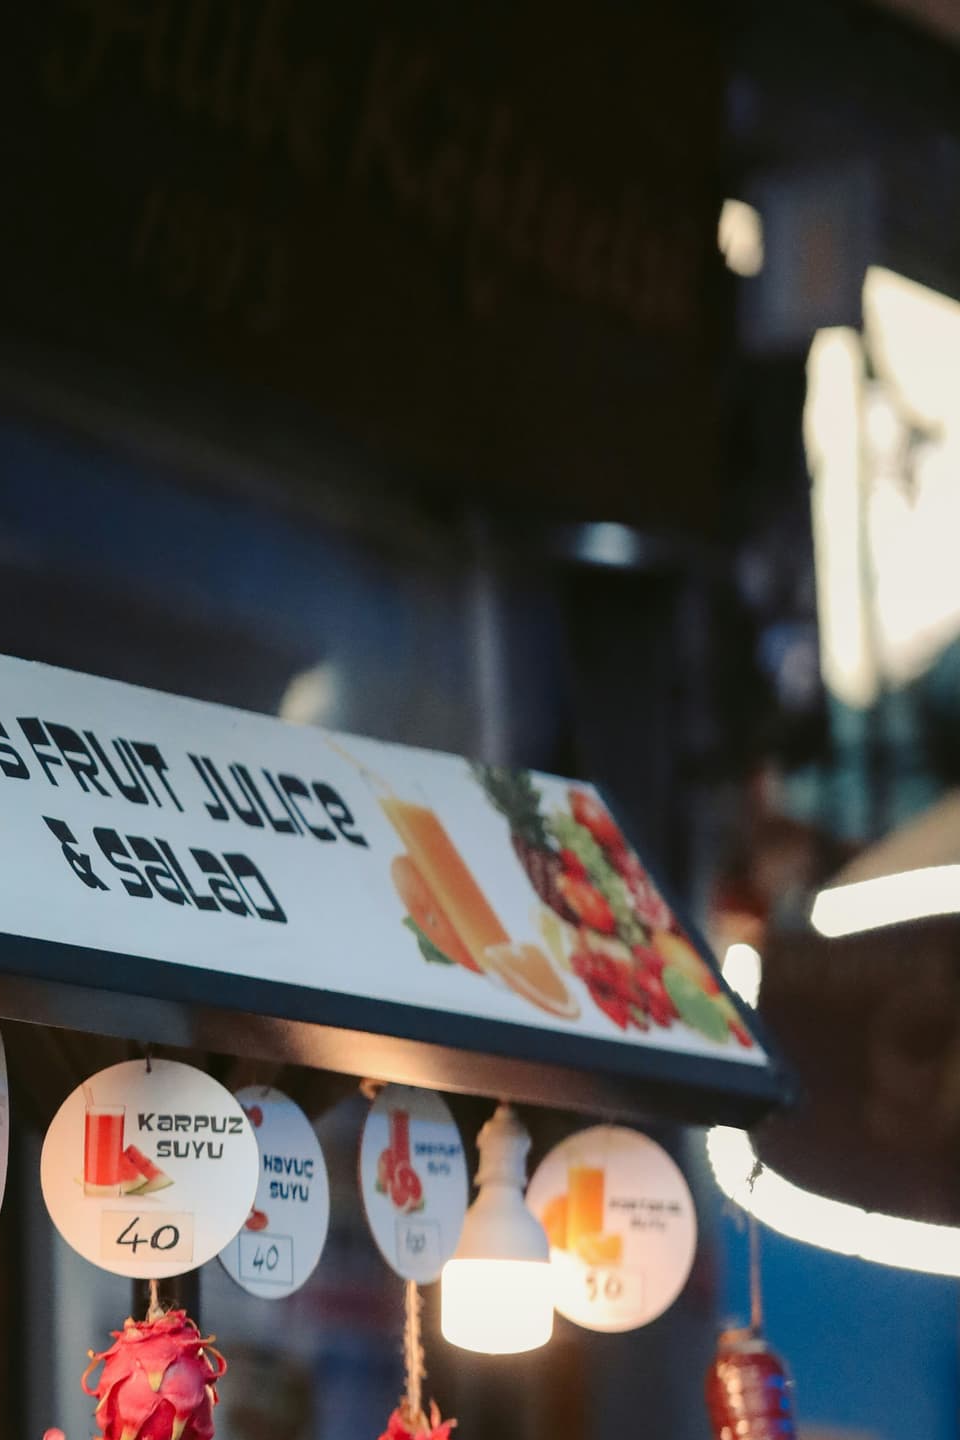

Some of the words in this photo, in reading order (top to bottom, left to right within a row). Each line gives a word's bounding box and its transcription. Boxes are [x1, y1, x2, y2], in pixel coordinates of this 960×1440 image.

[16, 717, 185, 813] FRUIT
[42, 815, 110, 891] &
[155, 1139, 224, 1160] SUYU
[270, 1181, 310, 1203] SUYU
[116, 1217, 181, 1254] 40
[253, 1244, 280, 1273] 40
